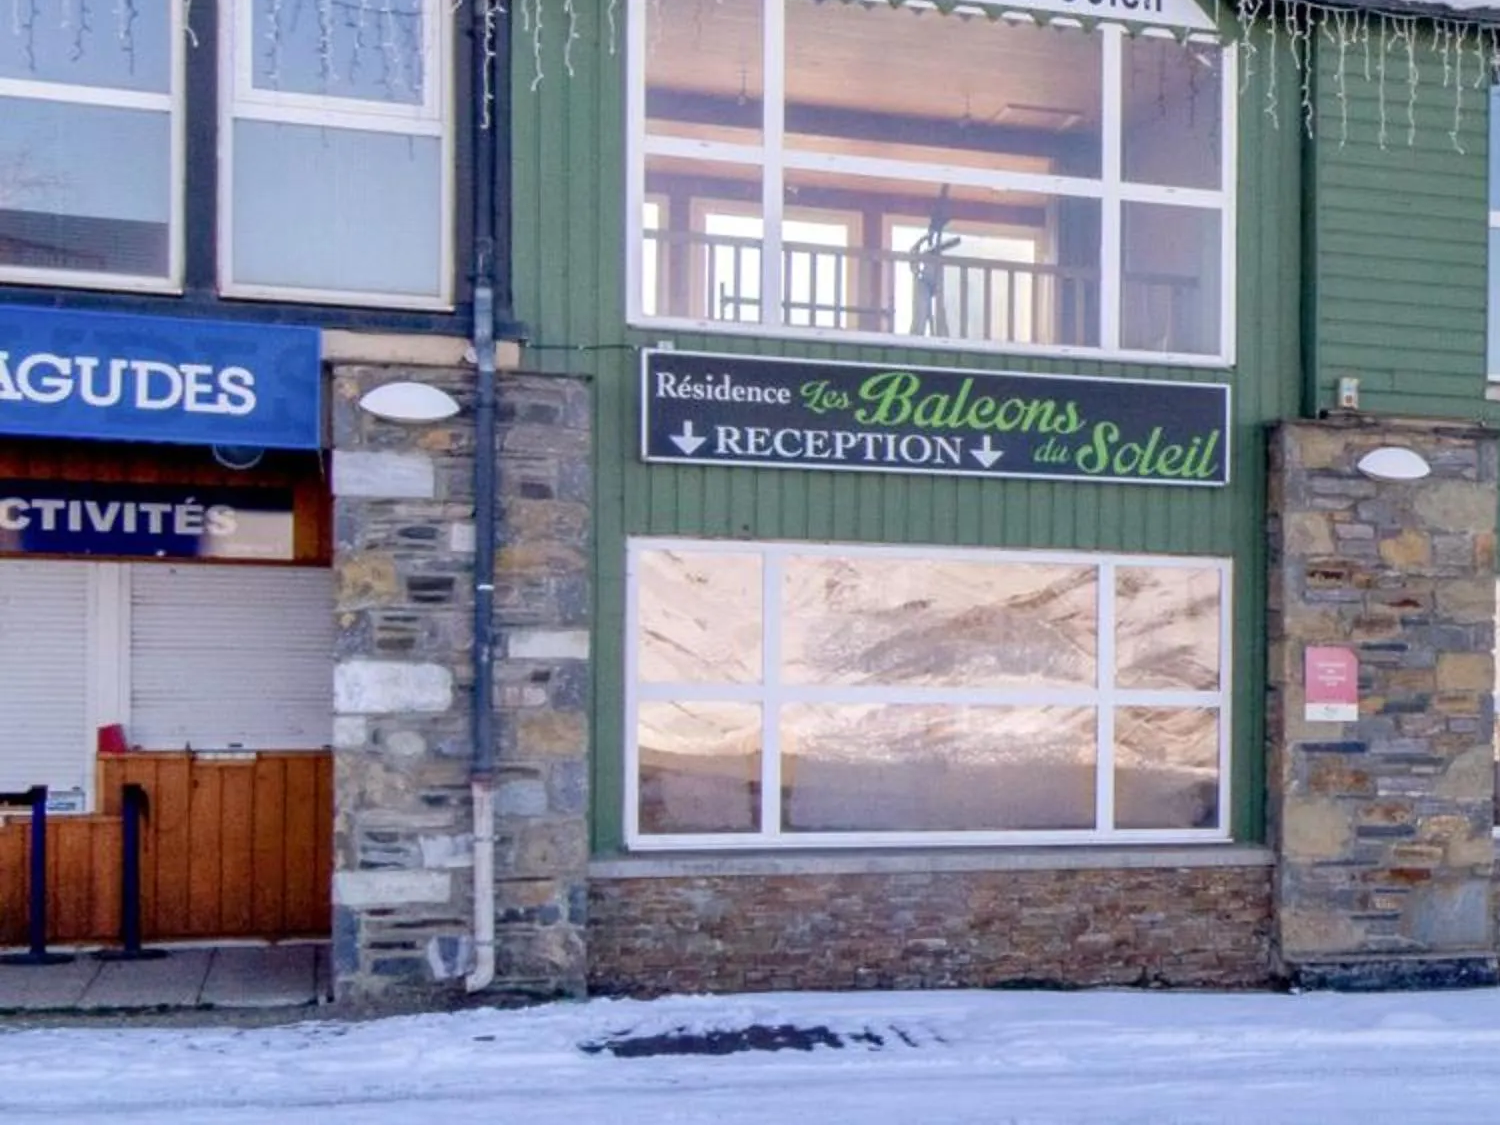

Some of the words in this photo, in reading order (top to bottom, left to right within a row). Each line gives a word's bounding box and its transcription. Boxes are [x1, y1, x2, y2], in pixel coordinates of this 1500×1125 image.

[655, 371, 792, 405] Résidence
[800, 379, 852, 414] Les
[854, 371, 1086, 435] Balcons
[714, 425, 963, 465] RECEPTION
[1032, 436, 1071, 464] du
[1075, 421, 1220, 478] Soleil
